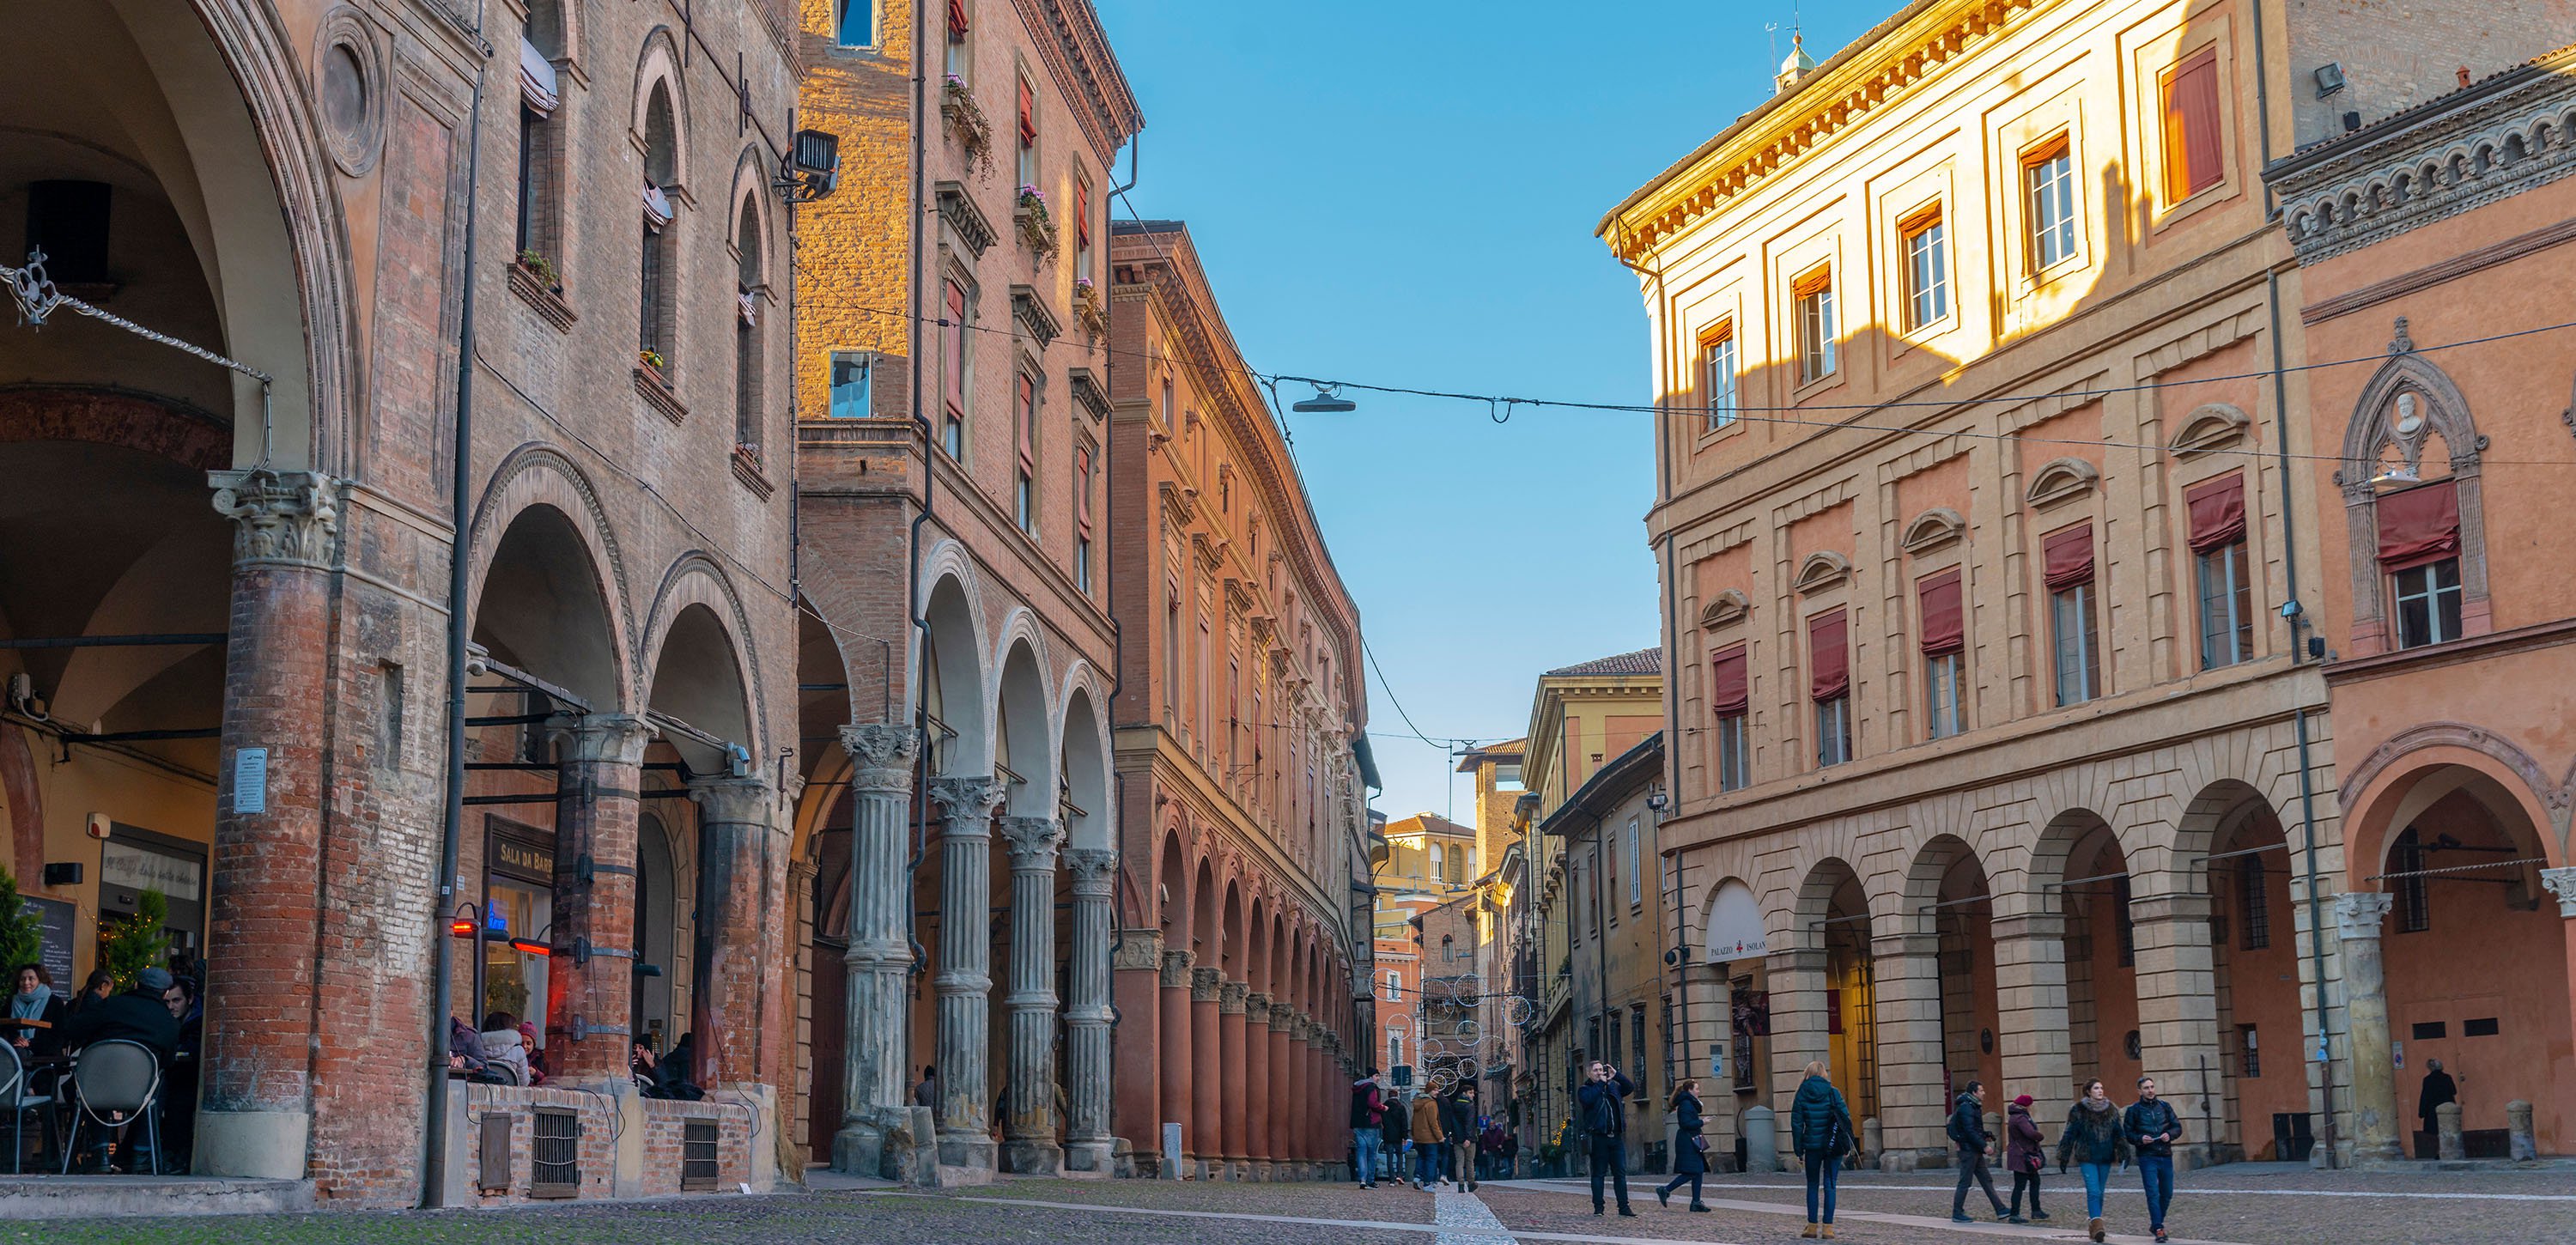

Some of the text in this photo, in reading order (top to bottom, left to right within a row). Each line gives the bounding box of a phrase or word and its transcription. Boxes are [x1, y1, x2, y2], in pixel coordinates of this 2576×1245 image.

[501, 843, 520, 865] SALA
[522, 851, 532, 868] DA
[1710, 946, 1733, 957] PALAZZO
